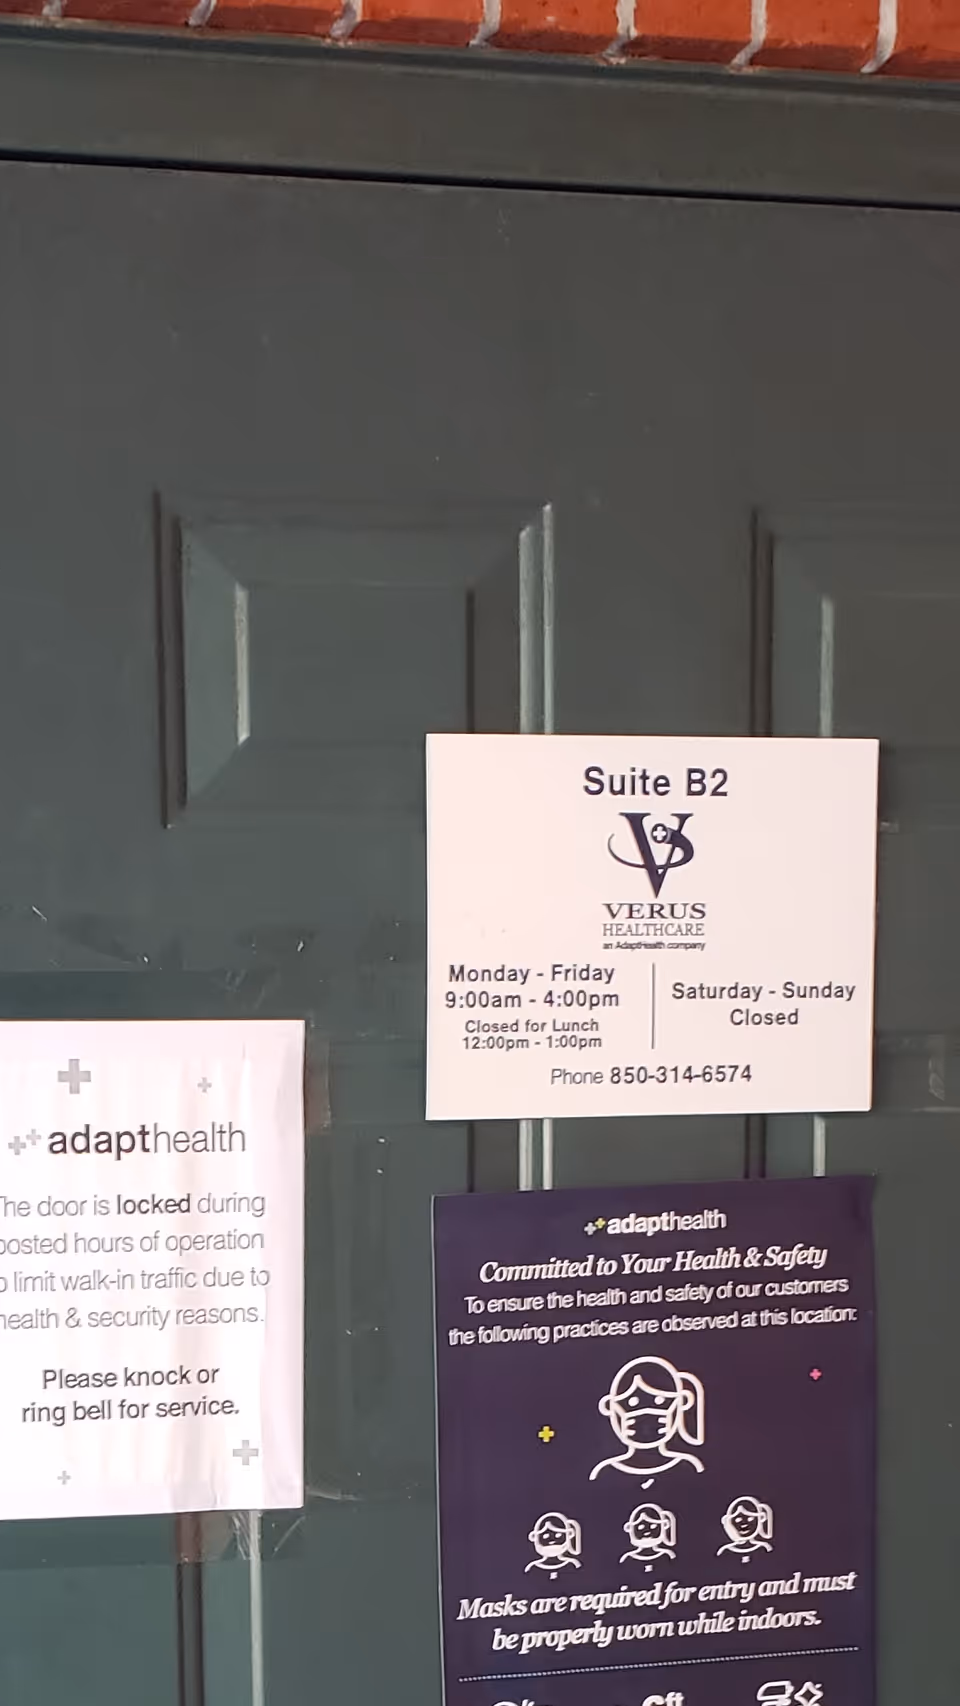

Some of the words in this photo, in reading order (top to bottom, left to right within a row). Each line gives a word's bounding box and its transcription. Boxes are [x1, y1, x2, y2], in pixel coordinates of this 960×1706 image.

[583, 766, 671, 796] Suite
[685, 768, 729, 797] B2
[602, 903, 706, 919] VERUS
[602, 923, 705, 936] HEALTHCARE
[667, 942, 706, 951] company
[448, 964, 531, 985] Monday
[551, 963, 615, 985] Friday
[445, 991, 522, 1009] 9:00am
[543, 990, 620, 1013] 4:00pm
[672, 981, 763, 1002] Saturday
[782, 981, 856, 1001] Sunday
[464, 1019, 520, 1034] Closed
[524, 1019, 548, 1033] for
[552, 1018, 599, 1032] Lunch
[730, 1009, 799, 1026] Closed
[462, 1036, 530, 1052] 12:00pm
[546, 1035, 602, 1051] 1:00pm
[551, 1067, 604, 1085] Phone
[610, 1064, 752, 1084] 850-314-6574
[48, 1122, 246, 1160] adapthealth
[37, 1196, 87, 1218] door
[93, 1196, 110, 1217] is
[116, 1194, 191, 1216] locked
[197, 1193, 266, 1218] during
[607, 1209, 727, 1236] adapthealth
[73, 1232, 134, 1254] hours
[140, 1231, 161, 1253] of
[165, 1229, 265, 1257] operation
[479, 1255, 593, 1284] Committed
[596, 1257, 617, 1276] to
[620, 1253, 672, 1276] Your
[672, 1247, 741, 1273] Health
[743, 1247, 762, 1268] &
[763, 1243, 828, 1270] Safety
[13, 1270, 56, 1292] limit
[60, 1269, 136, 1292] walk-in
[140, 1267, 198, 1290] traffic
[202, 1267, 245, 1288] due
[250, 1268, 271, 1288] to
[464, 1296, 485, 1314] To
[487, 1296, 543, 1314] ensure
[546, 1292, 574, 1310] the
[576, 1287, 627, 1308] health
[630, 1285, 662, 1305] and
[665, 1282, 714, 1304] safety
[716, 1280, 735, 1299] of
[735, 1281, 763, 1299] our
[764, 1276, 849, 1297] customers
[65, 1308, 83, 1329] &
[87, 1305, 169, 1331] security
[175, 1306, 265, 1326] reasons.
[448, 1327, 475, 1346] the
[478, 1322, 550, 1345] following
[553, 1318, 629, 1343] practices
[632, 1317, 659, 1335] are
[661, 1312, 738, 1333] observed
[741, 1311, 757, 1328] at
[760, 1308, 788, 1327] this
[791, 1305, 858, 1325] location:
[42, 1368, 118, 1390] Please
[124, 1366, 192, 1388] knock
[196, 1367, 220, 1385] or
[21, 1402, 66, 1427] ring
[73, 1399, 112, 1422] bell
[118, 1398, 150, 1420] for
[155, 1397, 240, 1419] service.
[456, 1594, 528, 1621] Masks
[530, 1598, 566, 1615] are
[569, 1588, 662, 1614] required
[658, 1581, 697, 1610] for
[698, 1580, 755, 1603] entry
[757, 1573, 801, 1597] and
[802, 1571, 858, 1593] must
[492, 1626, 518, 1651] be
[518, 1619, 615, 1655] properly
[617, 1624, 675, 1642] worn
[677, 1611, 735, 1637] while
[737, 1605, 822, 1632] indoors.
